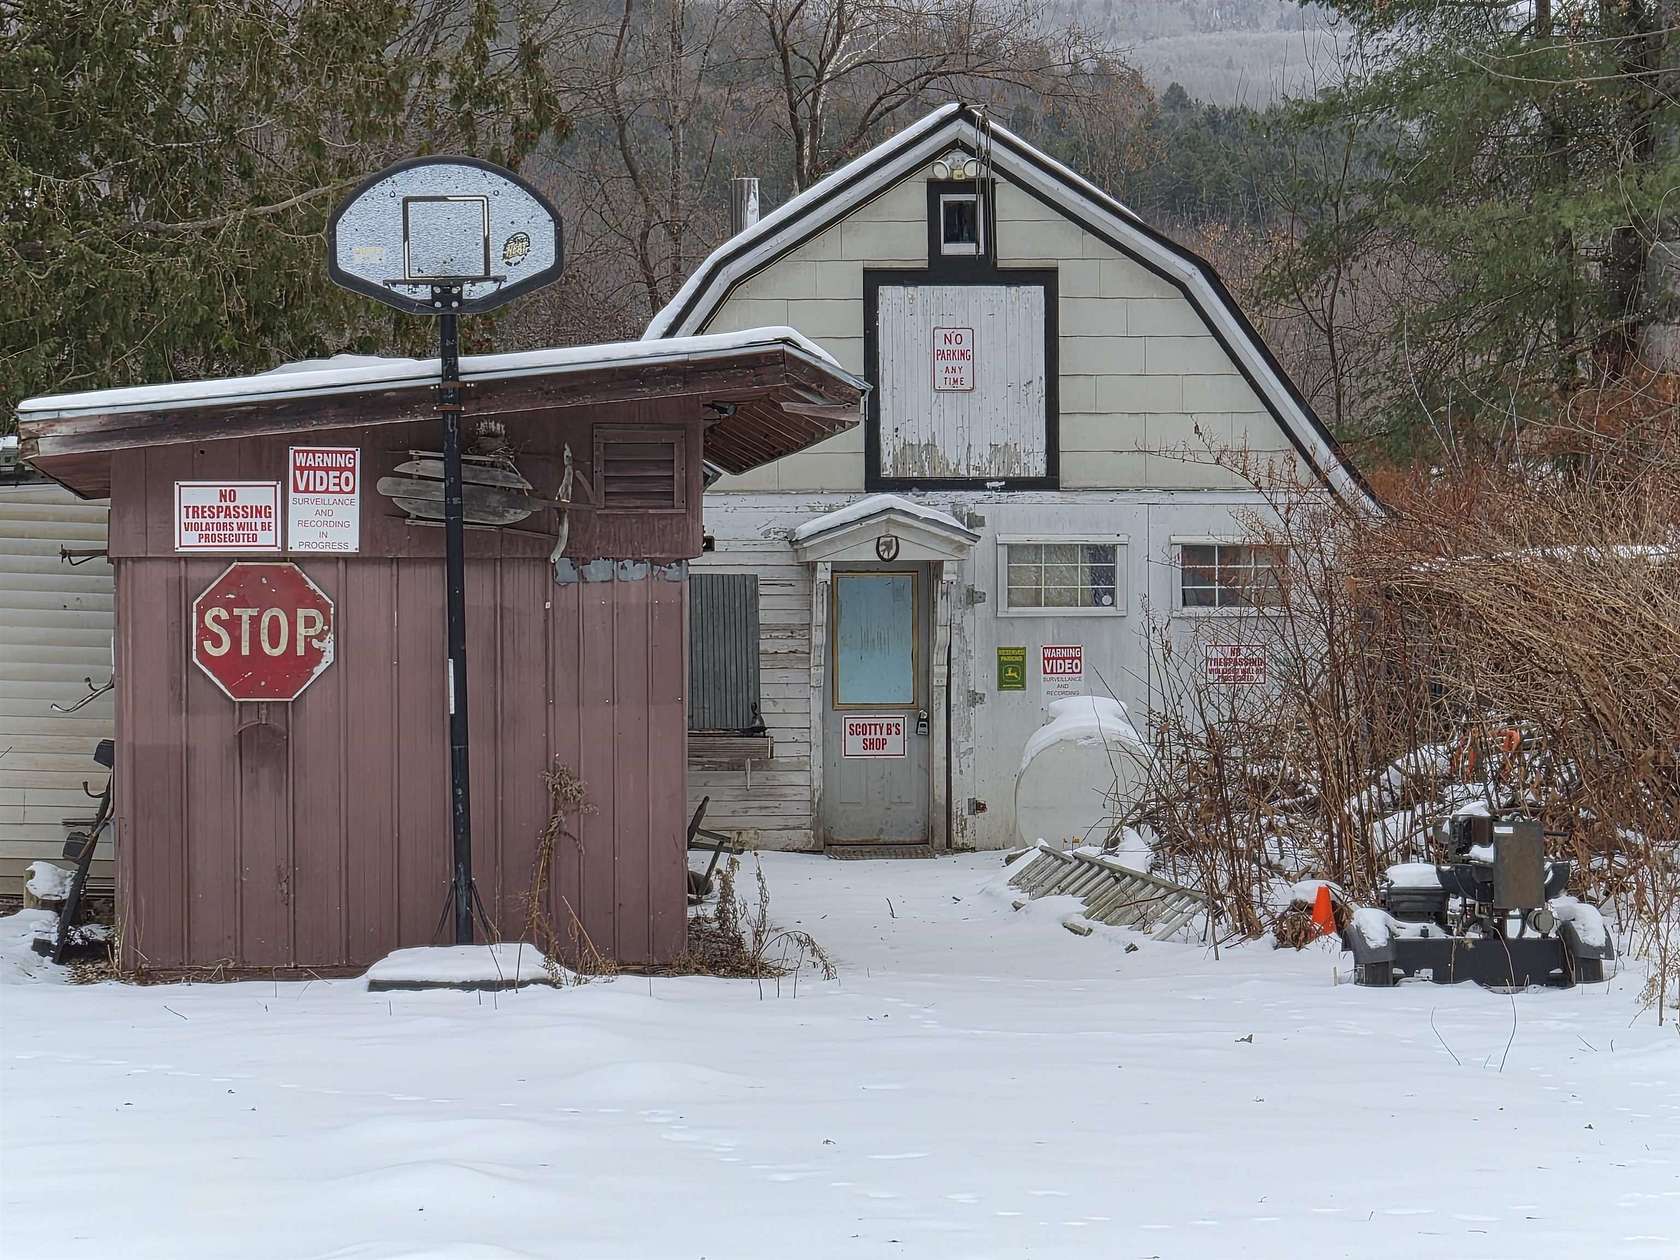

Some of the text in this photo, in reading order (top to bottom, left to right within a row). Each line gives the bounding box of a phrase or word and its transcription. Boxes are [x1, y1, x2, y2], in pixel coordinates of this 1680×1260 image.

[944, 333, 963, 345] NO
[936, 349, 971, 361] PARKING
[944, 366, 963, 374] ANY
[944, 377, 965, 385] TIME
[295, 452, 354, 467] WARNING
[295, 470, 354, 492] VIDEO
[219, 489, 237, 503] NO
[292, 497, 356, 506] SURVEILLANCE
[183, 505, 272, 519] TRESPASSING
[314, 508, 334, 517] AND
[183, 521, 273, 532] VIOLATORS WILL BE
[297, 519, 351, 528] RECORDING
[198, 533, 258, 543] PROSECUTED
[319, 531, 328, 539] IN
[298, 541, 349, 550] PROGRESS
[203, 607, 324, 657] STOP
[1043, 648, 1081, 658] WARNING
[1044, 659, 1081, 673] VIDEO
[848, 722, 901, 736] SCOTTY B'S
[862, 737, 888, 751] SHOP
